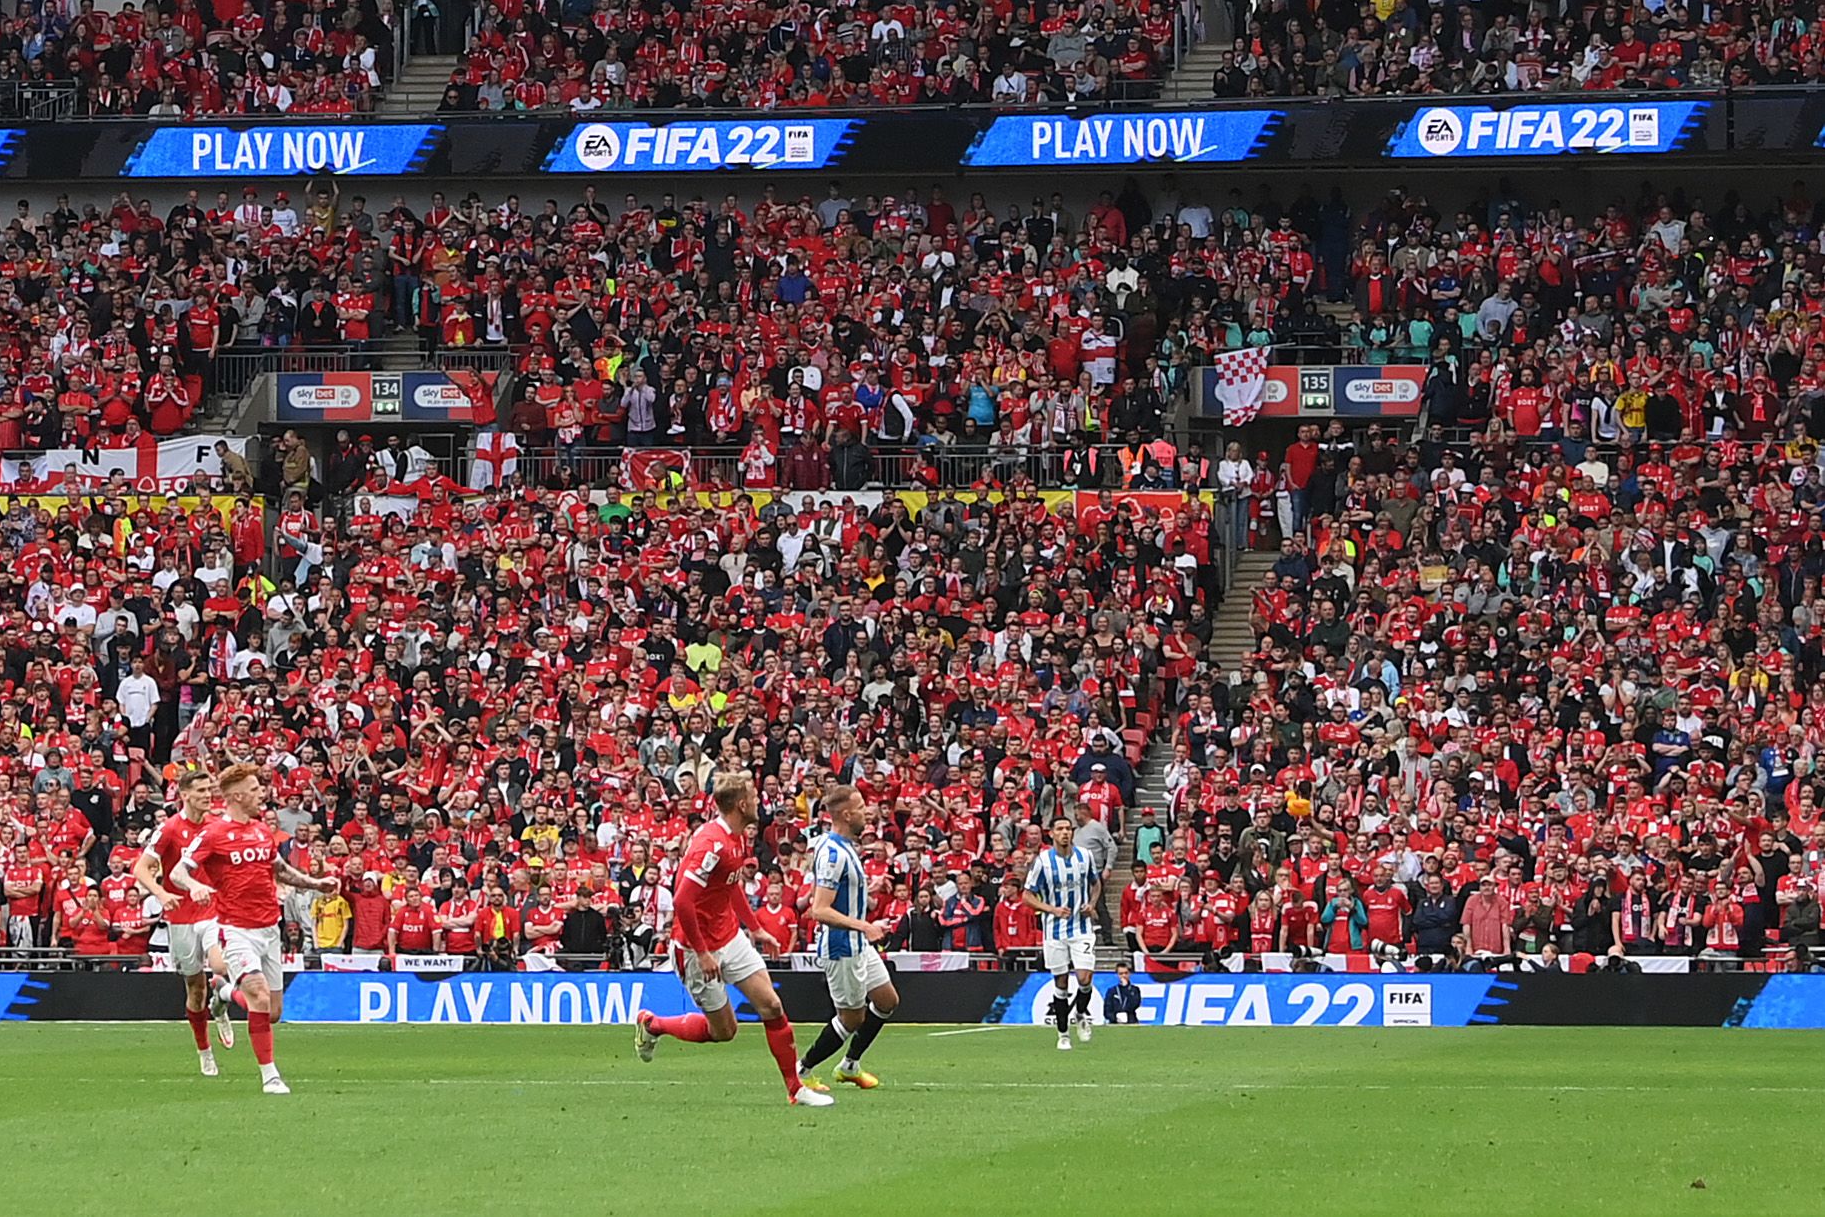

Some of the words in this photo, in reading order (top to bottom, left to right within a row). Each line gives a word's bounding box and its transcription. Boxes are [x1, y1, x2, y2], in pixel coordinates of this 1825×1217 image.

[1466, 110, 1564, 149] FIFA
[1569, 108, 1625, 147] 22
[624, 127, 721, 164] FIFA
[724, 125, 781, 162] 22
[1032, 120, 1112, 158] PLAY
[1123, 118, 1205, 156] NOW
[192, 133, 273, 170] PLAY
[283, 132, 364, 169] NOW
[374, 383, 399, 396] 134
[1302, 376, 1328, 390] 135
[1354, 383, 1371, 393] sky
[1373, 382, 1392, 392] bet
[297, 390, 314, 399] sky
[317, 389, 334, 398] bet
[422, 389, 439, 398] sky
[442, 388, 460, 397] bet
[82, 448, 100, 465] N
[196, 445, 211, 463] F
[229, 848, 271, 866] BOXT
[402, 924, 424, 933] BOXT
[1083, 943, 1091, 954] 2
[404, 958, 418, 967] WE
[422, 957, 453, 967] WANT
[359, 982, 493, 1023] PLAY
[510, 982, 644, 1024] NOW
[1136, 983, 1273, 1026] FIFA
[1285, 982, 1375, 1026] 22
[1389, 991, 1425, 1005] FIFA
